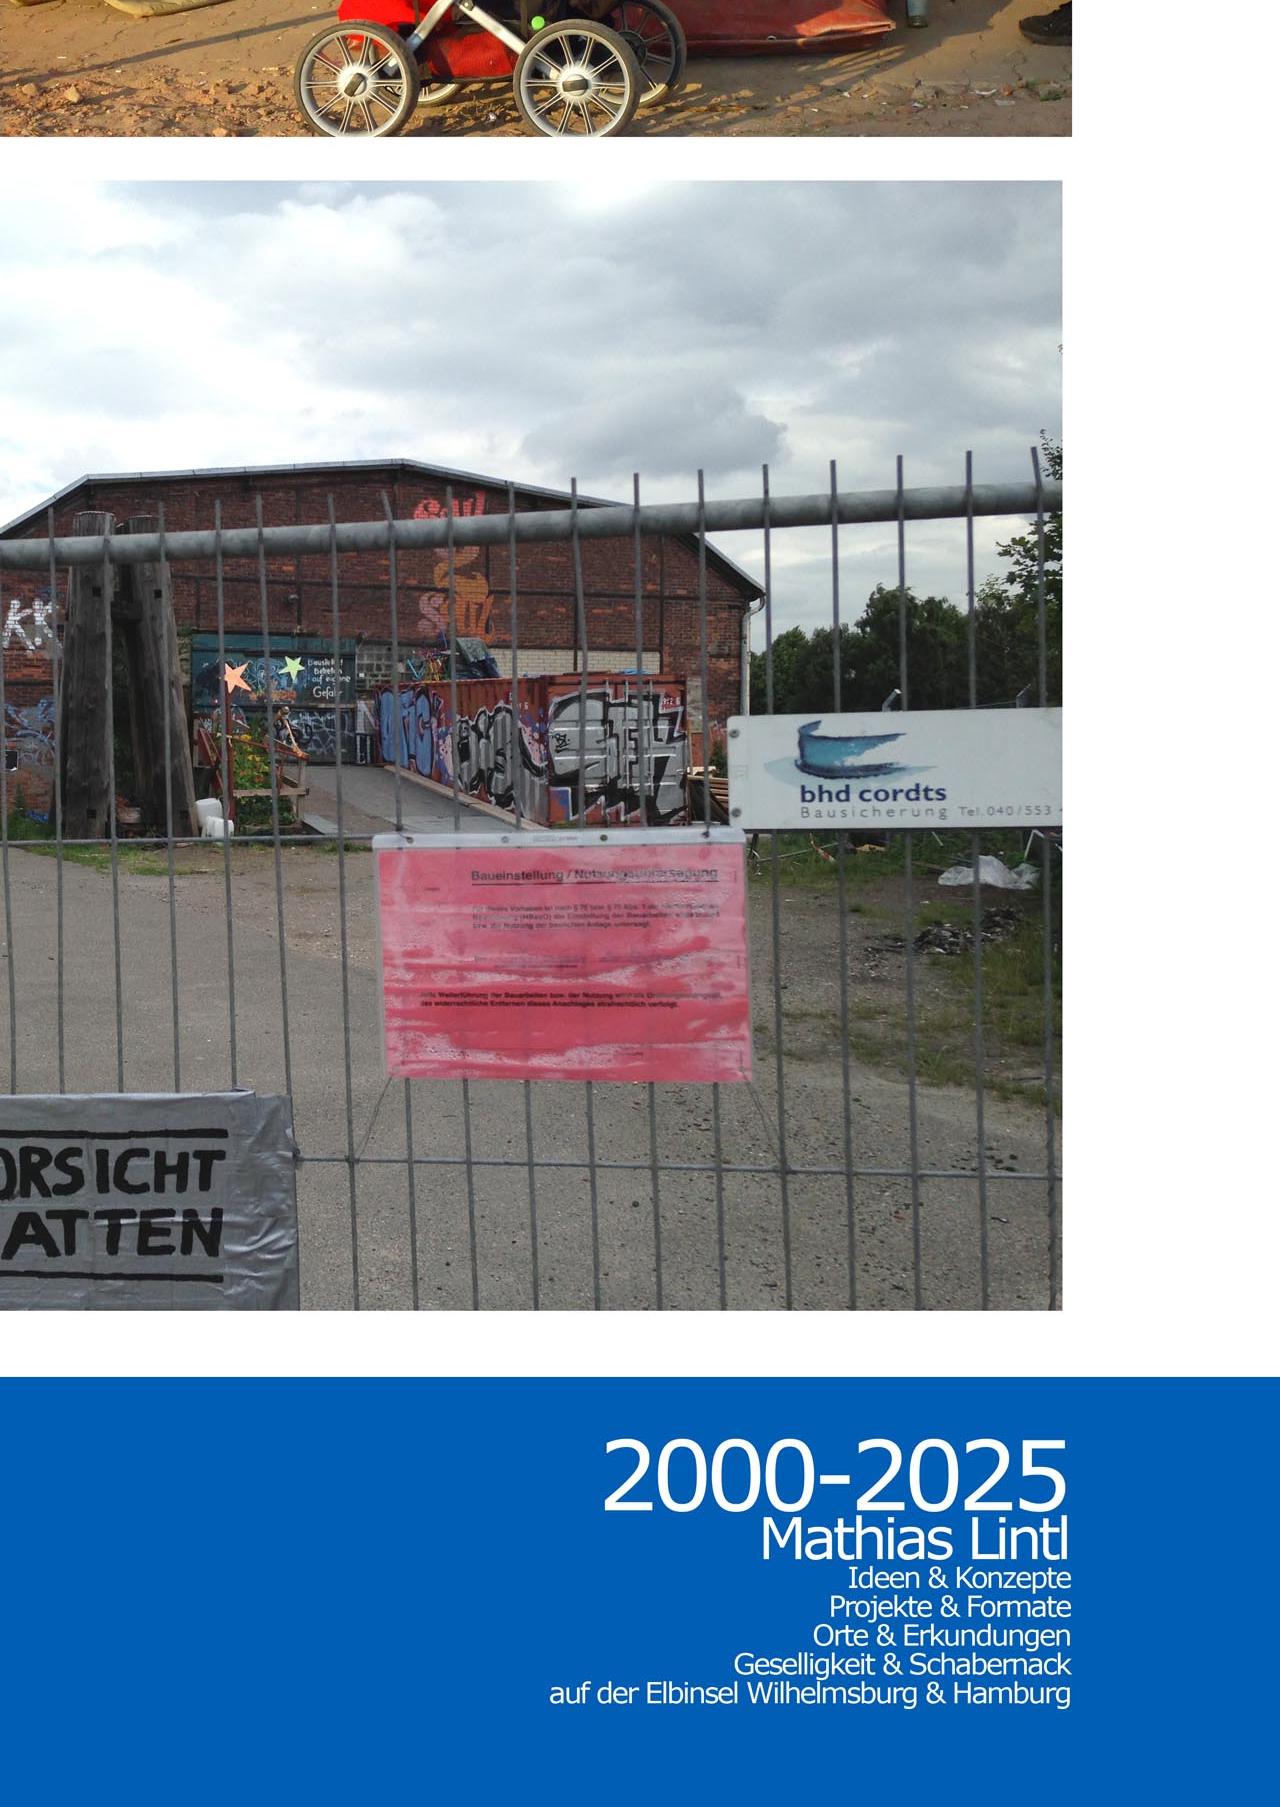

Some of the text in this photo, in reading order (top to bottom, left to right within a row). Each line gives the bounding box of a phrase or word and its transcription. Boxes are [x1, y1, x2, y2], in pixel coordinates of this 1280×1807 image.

[800, 783, 947, 803] bhd cordts
[800, 806, 948, 820] Bausicherung
[471, 869, 564, 882] Baueinstellung
